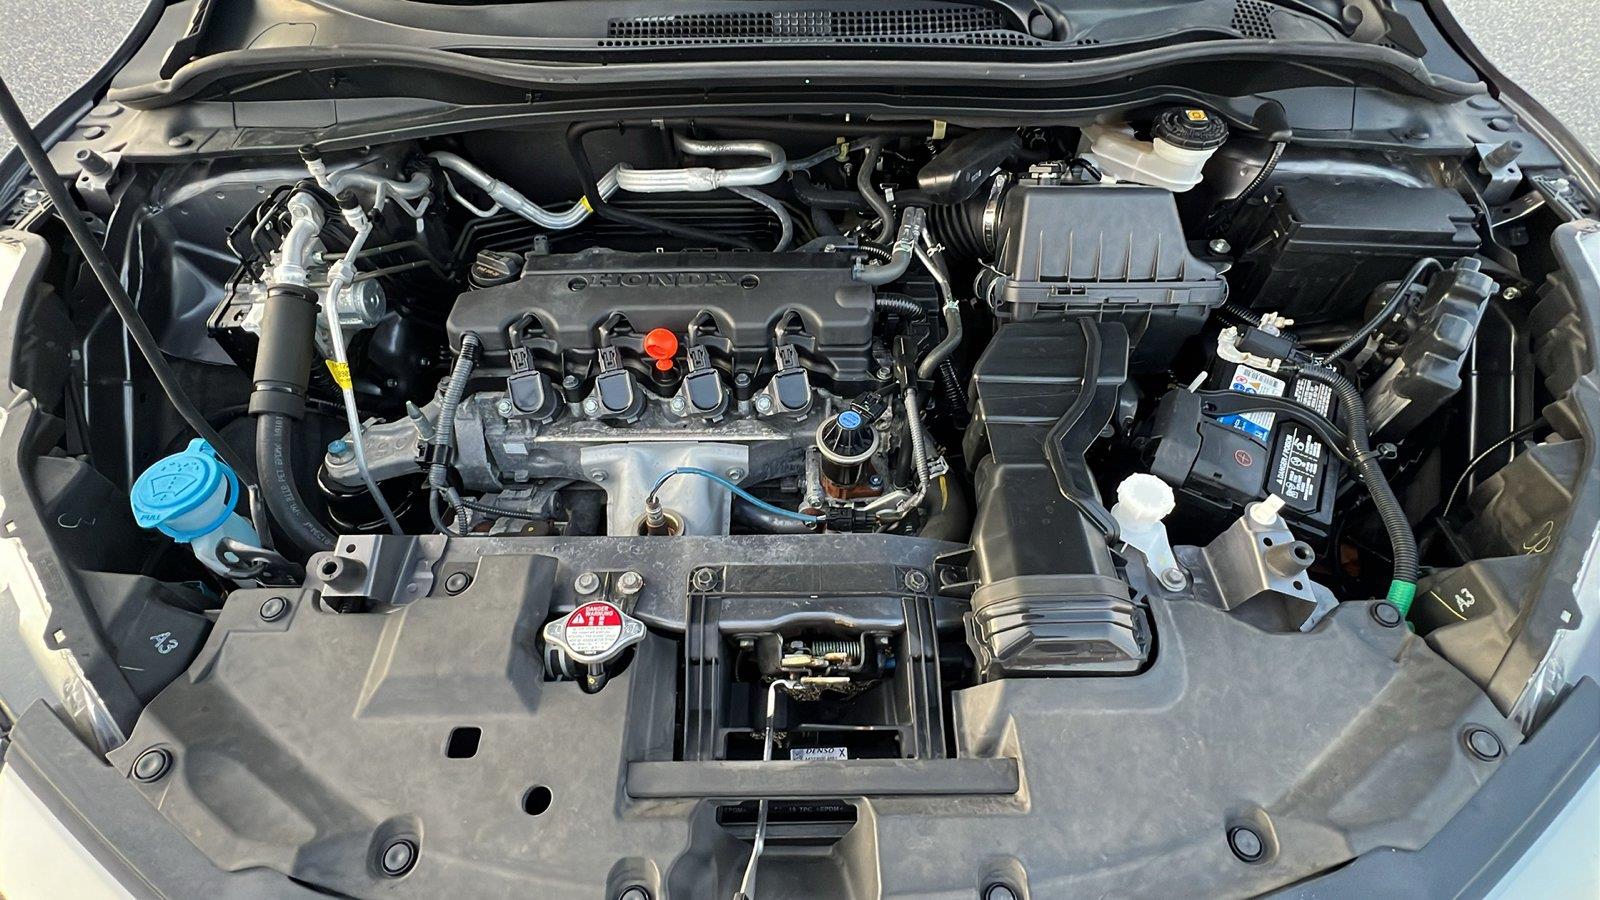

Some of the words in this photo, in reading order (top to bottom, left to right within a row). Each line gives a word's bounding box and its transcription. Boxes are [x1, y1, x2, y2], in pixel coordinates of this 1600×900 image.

[589, 273, 739, 287] HONDA
[1277, 457, 1287, 479] DANGER
[1283, 434, 1293, 454] POISON
[1455, 588, 1475, 612] A3
[150, 631, 179, 654] A3
[839, 748, 846, 757] X
